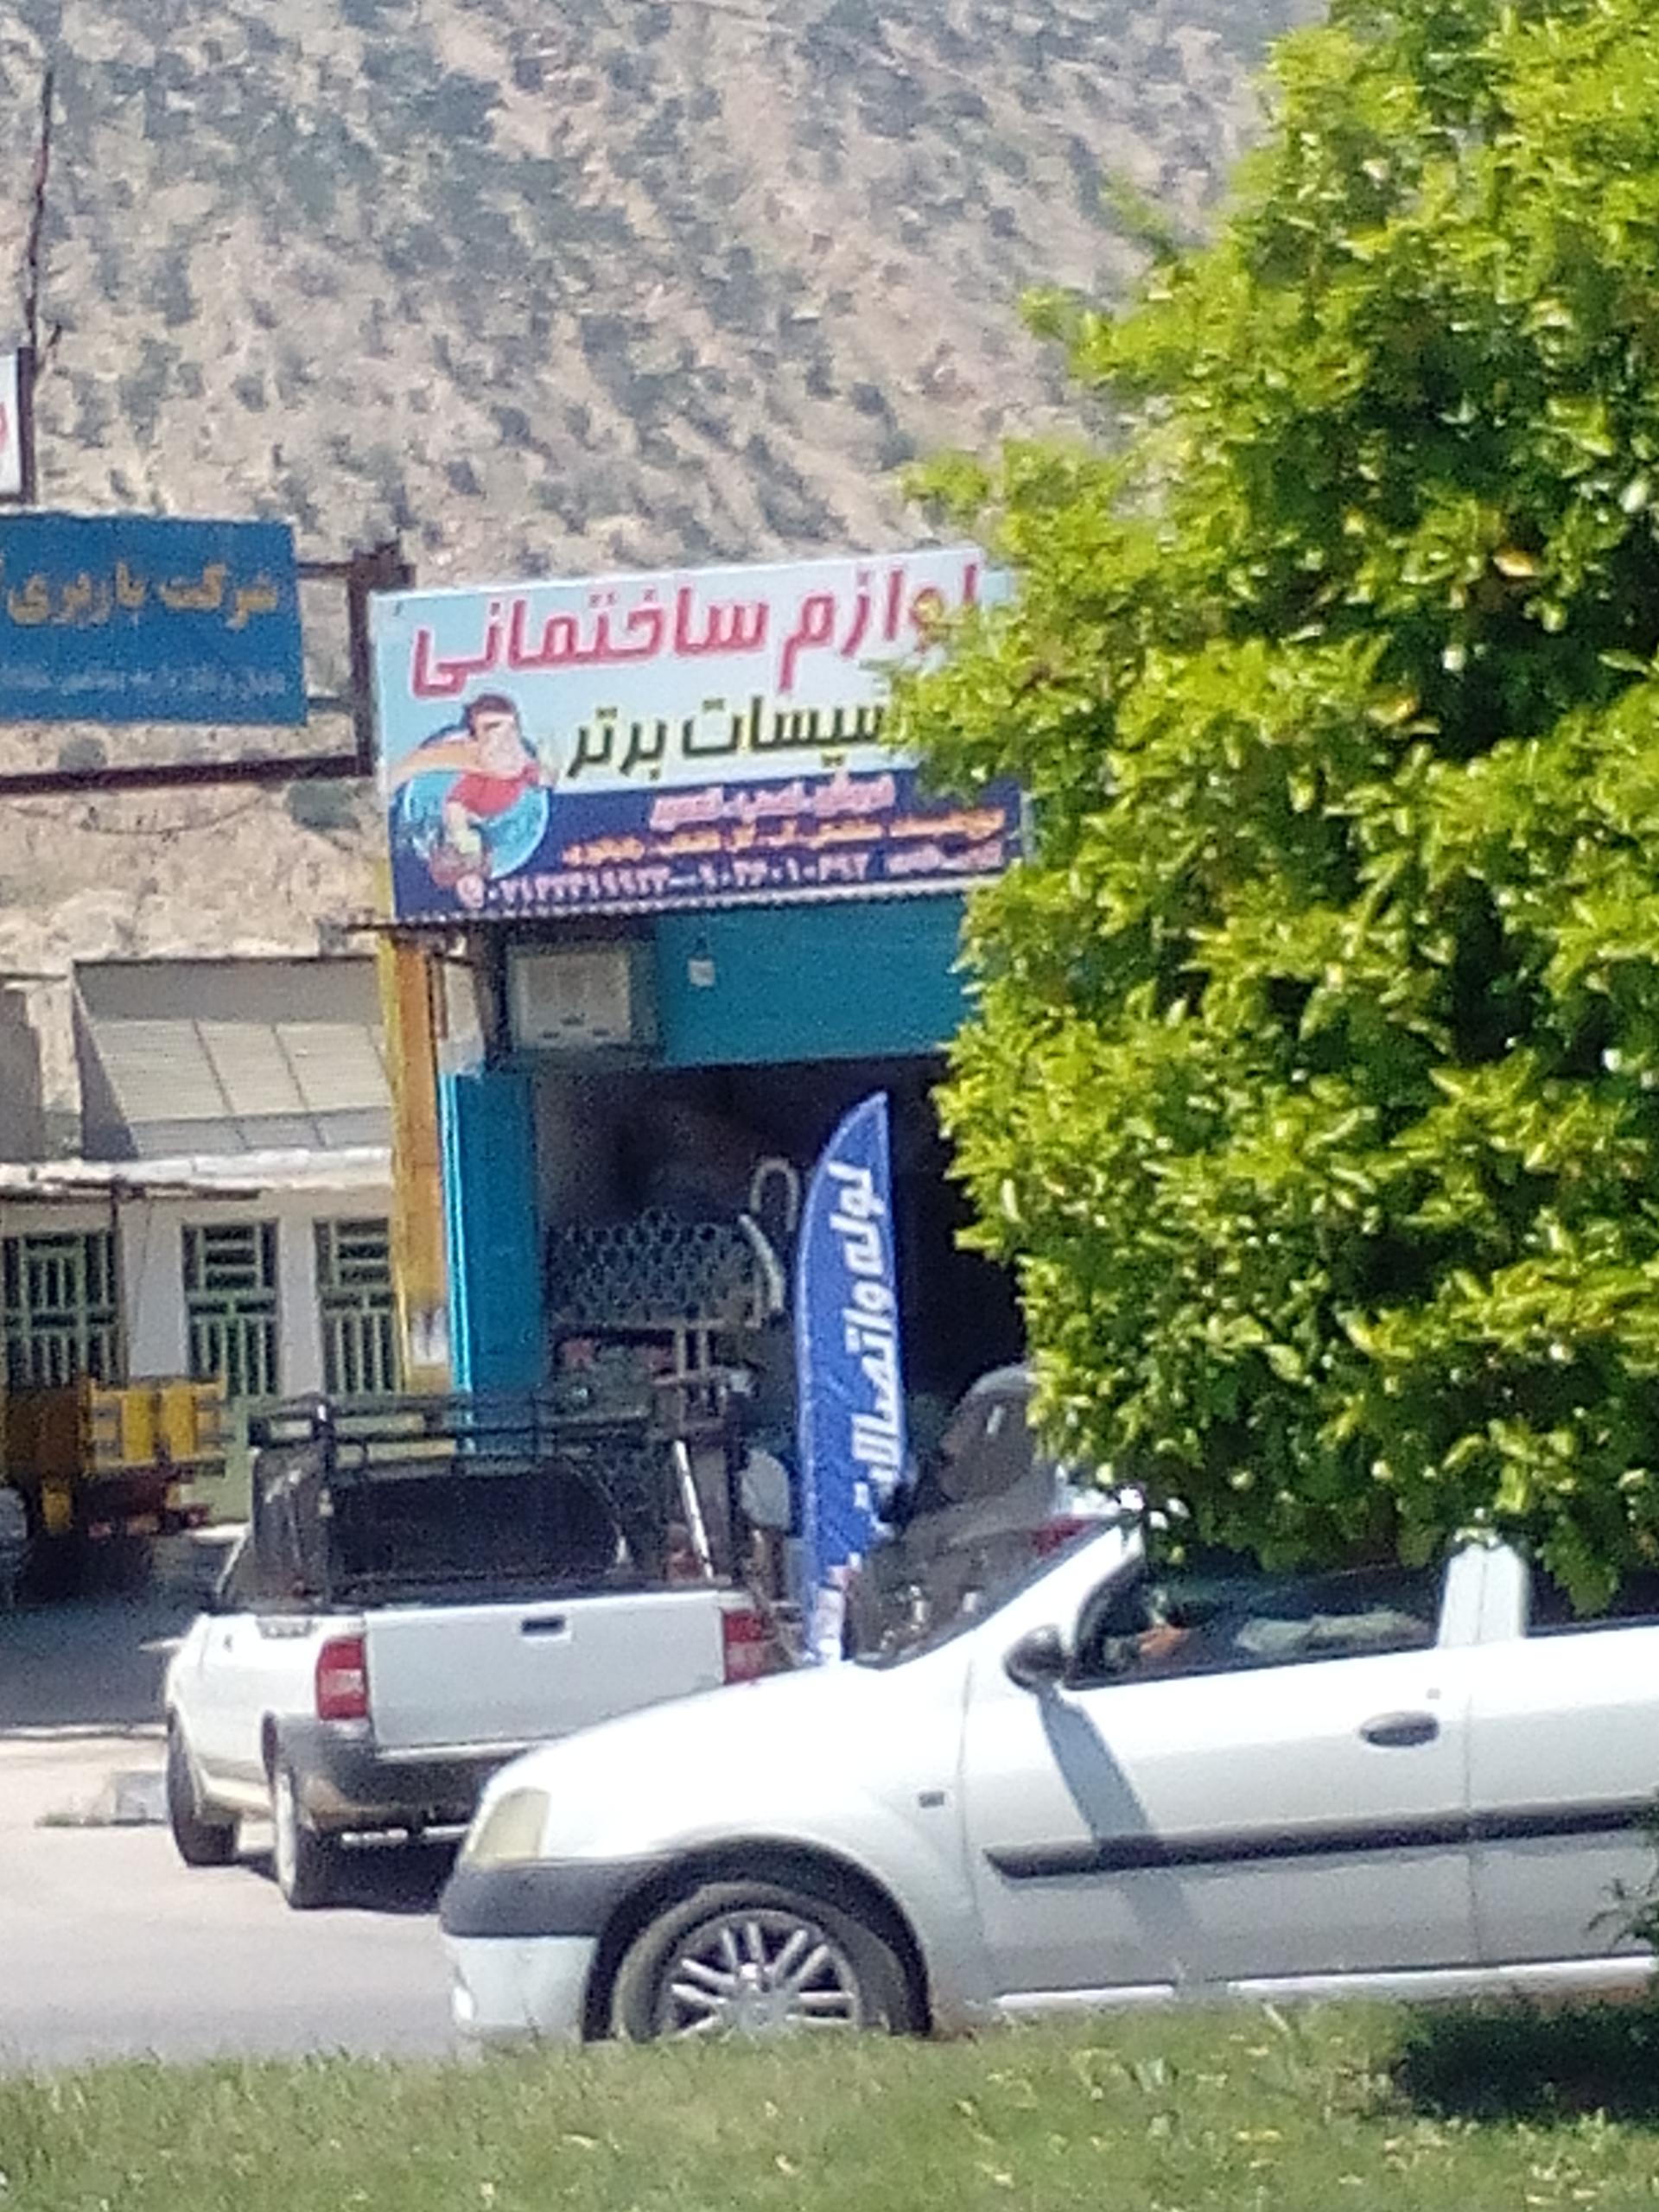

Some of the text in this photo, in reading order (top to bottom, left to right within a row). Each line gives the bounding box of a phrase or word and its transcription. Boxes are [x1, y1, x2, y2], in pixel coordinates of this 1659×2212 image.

[411, 585, 770, 697] ساختمانی
[566, 695, 885, 779] سیسات برتر
[827, 1160, 886, 1275] لوله
